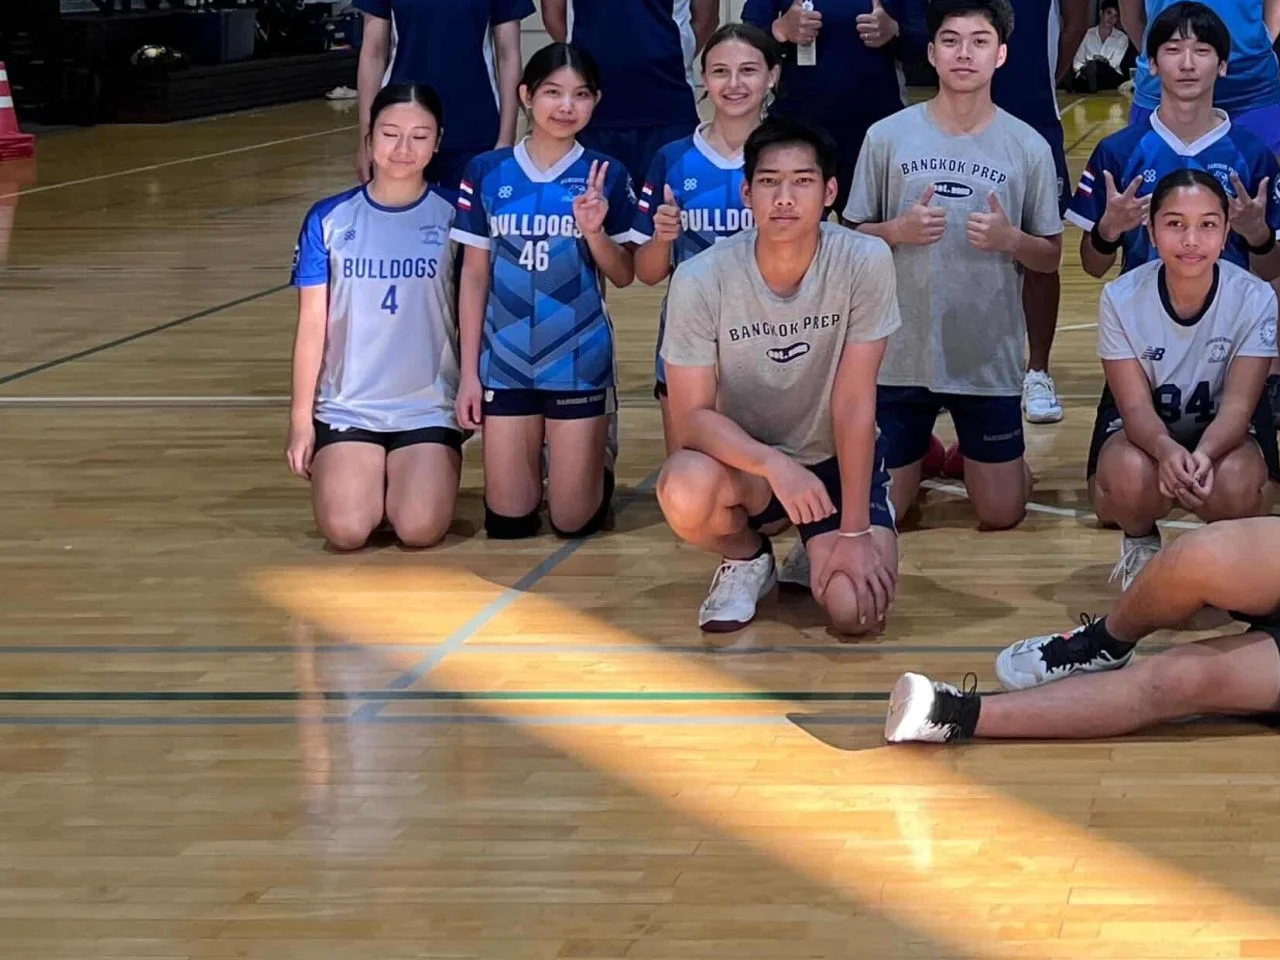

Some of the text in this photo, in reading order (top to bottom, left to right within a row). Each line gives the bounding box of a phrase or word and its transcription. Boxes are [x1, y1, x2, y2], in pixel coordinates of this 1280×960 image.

[901, 158, 1007, 184] BANGKOK PREP
[680, 208, 754, 232] BULLDO
[343, 257, 438, 279] BULLDOGS
[518, 240, 550, 271] 46
[380, 284, 399, 315] 4
[729, 314, 840, 341] BANGKOK PREP
[1154, 380, 1215, 424] 84
